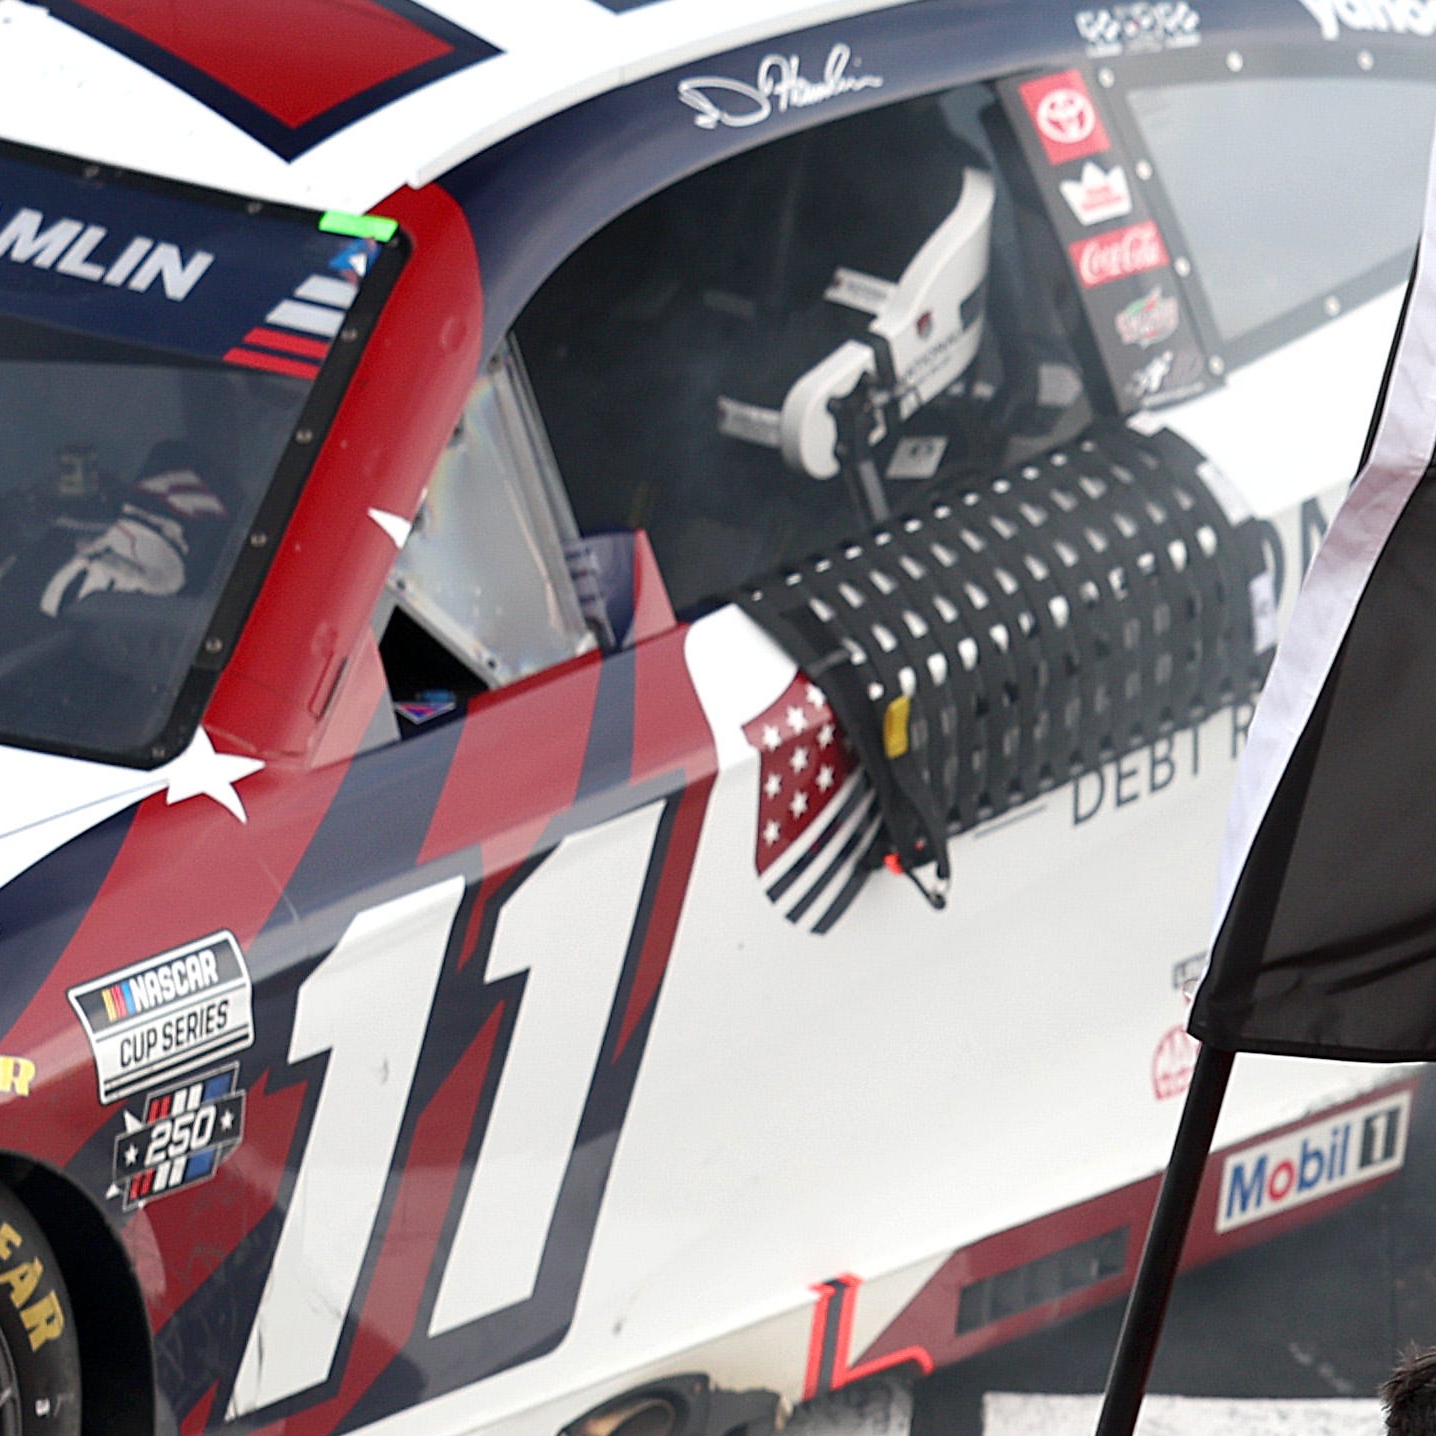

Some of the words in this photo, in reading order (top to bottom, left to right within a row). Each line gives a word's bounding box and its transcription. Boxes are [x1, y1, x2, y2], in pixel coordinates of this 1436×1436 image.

[128, 950, 218, 1016] NASCAR
[119, 1022, 159, 1068] CUP
[161, 1000, 230, 1060] SERIES
[145, 1107, 215, 1167] 250
[224, 800, 666, 1424] 11
[1225, 1123, 1352, 1219] Mobil
